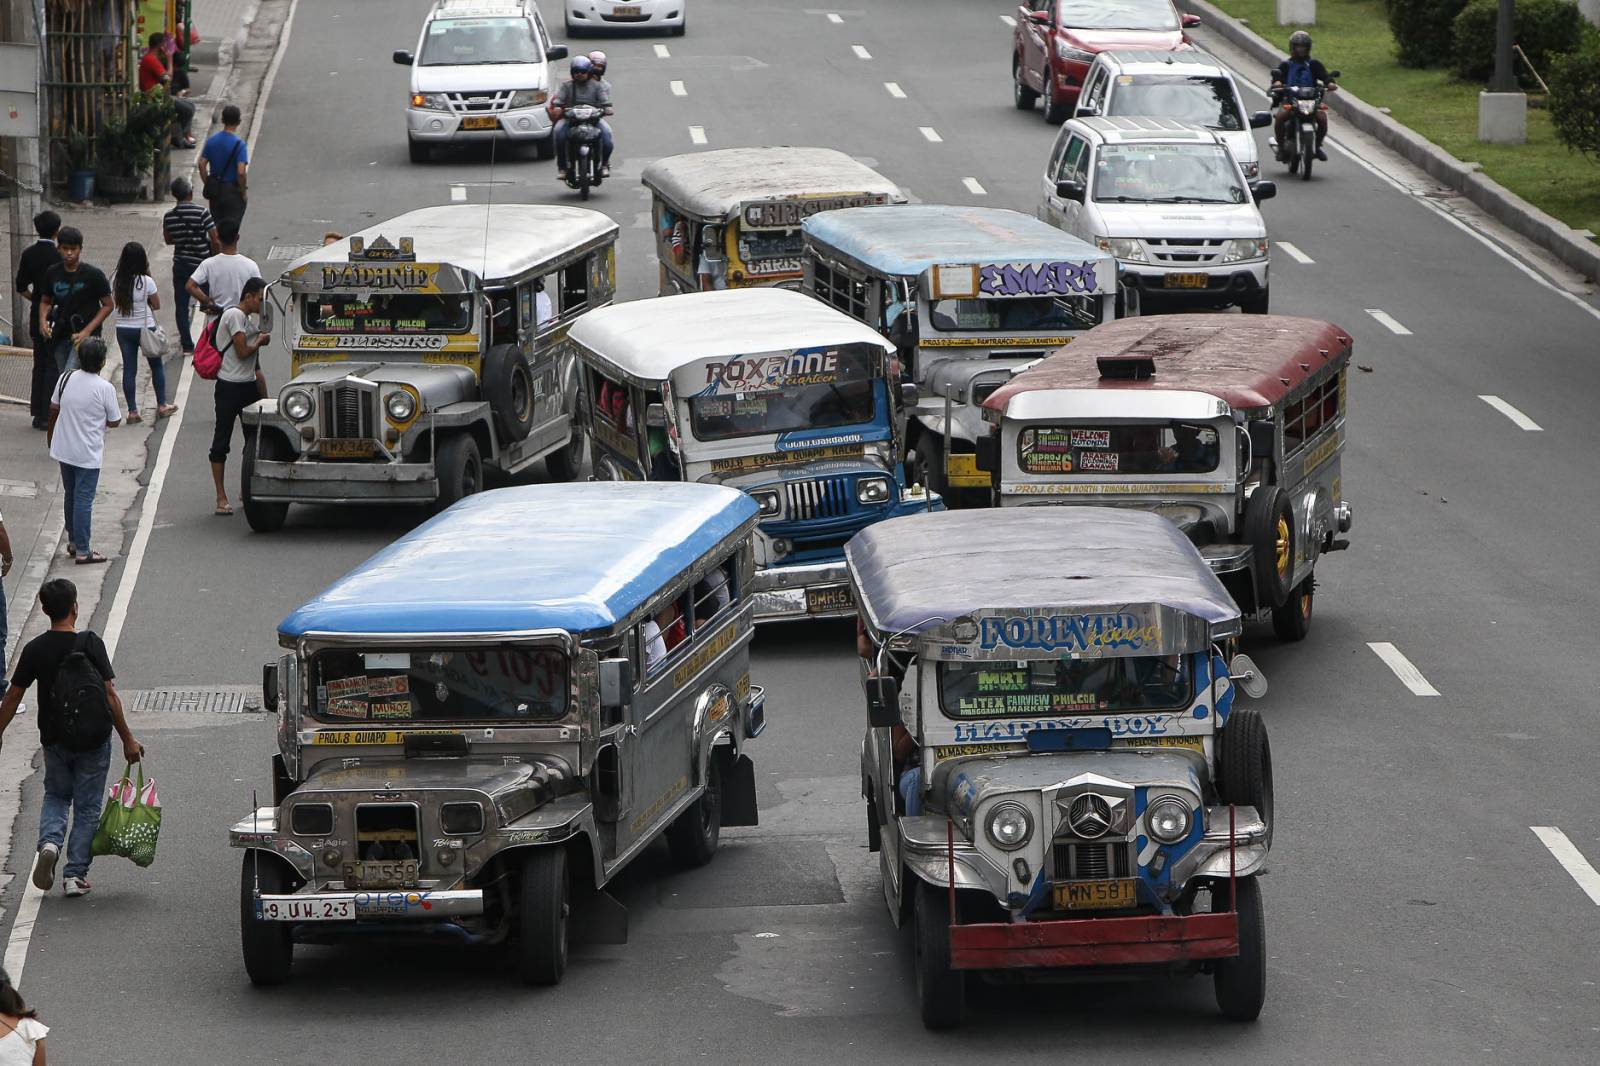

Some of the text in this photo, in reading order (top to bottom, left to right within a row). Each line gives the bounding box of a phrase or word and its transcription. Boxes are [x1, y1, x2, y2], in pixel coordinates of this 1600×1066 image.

[337, 335, 443, 349] BLESSING
[1072, 431, 1108, 439] WELCOME
[1062, 453, 1072, 471] 6
[978, 671, 1027, 684] MRT
[978, 683, 1027, 691] HI-WAY
[960, 697, 1004, 708] LITEX
[1007, 694, 1050, 705] FAIRVIEW
[1103, 714, 1174, 735] BOY
[318, 732, 350, 744] PROJ.8
[355, 732, 386, 743] QUIAPO
[1101, 881, 1132, 899] 581
